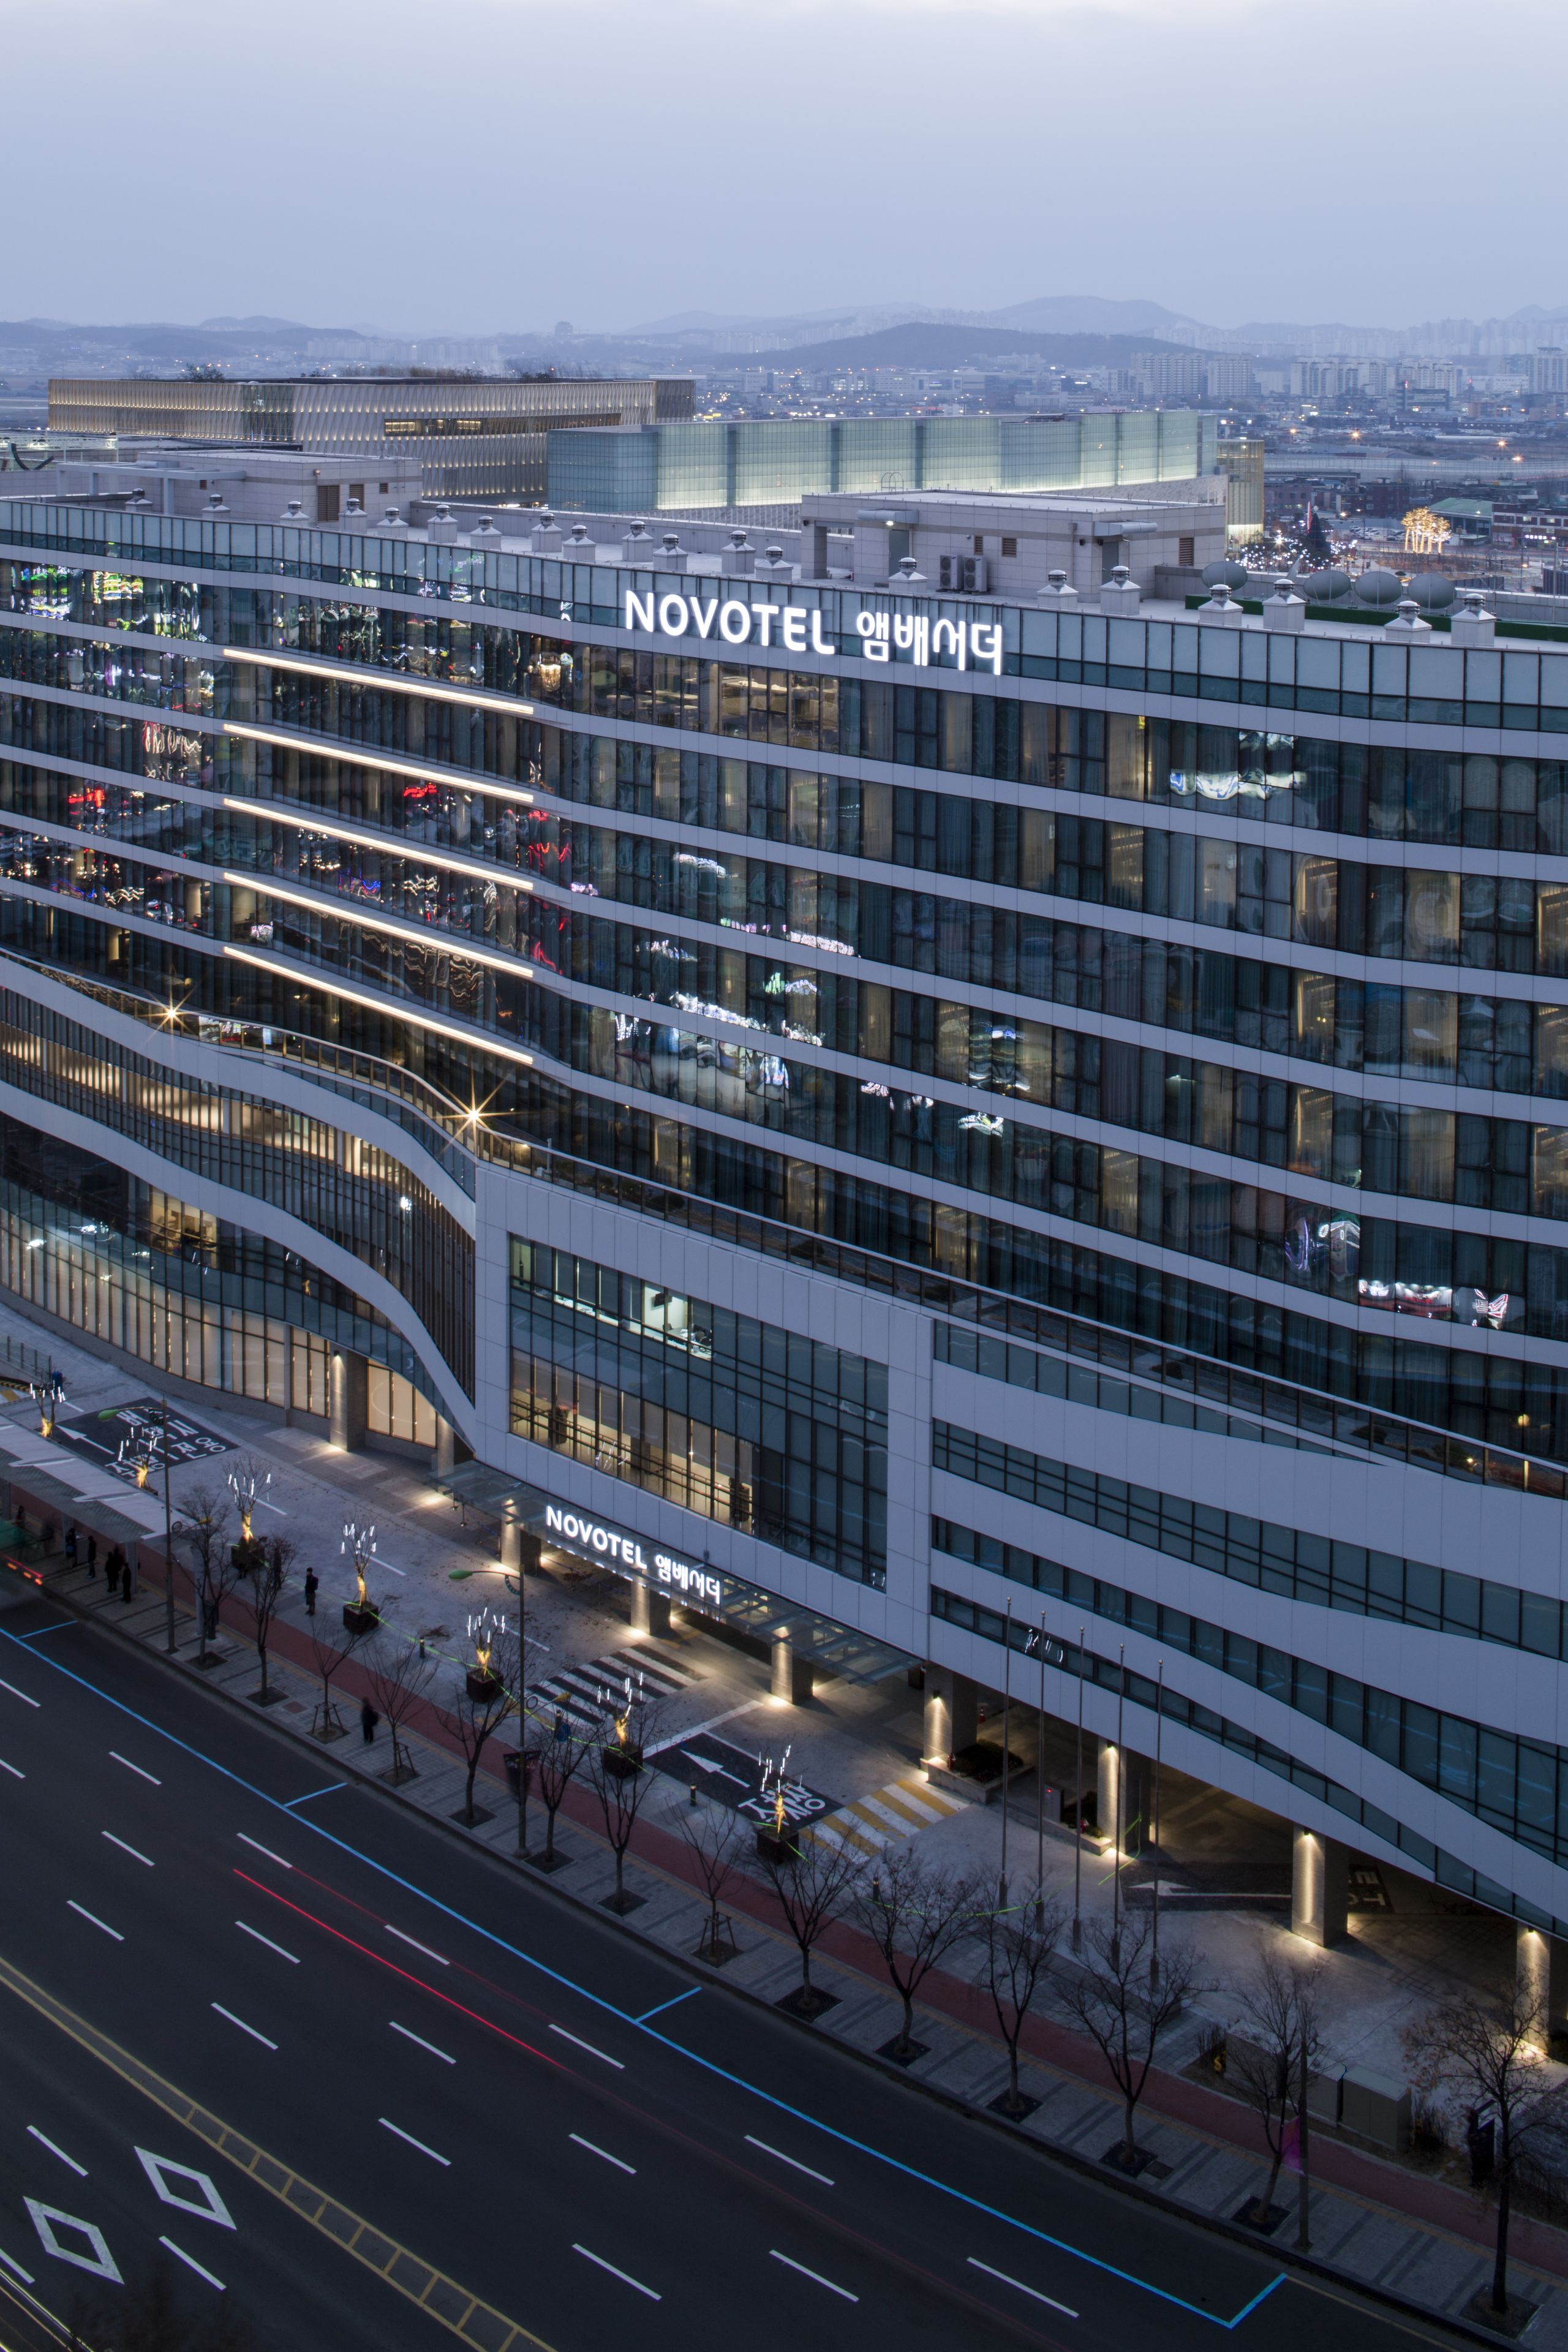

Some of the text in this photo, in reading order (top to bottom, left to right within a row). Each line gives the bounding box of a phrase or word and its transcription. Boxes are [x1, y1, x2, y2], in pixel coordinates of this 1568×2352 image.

[625, 590, 1002, 676] NOVOTEL 앰배서더
[546, 1505, 720, 1604] NOVOTEL 앰배서더
